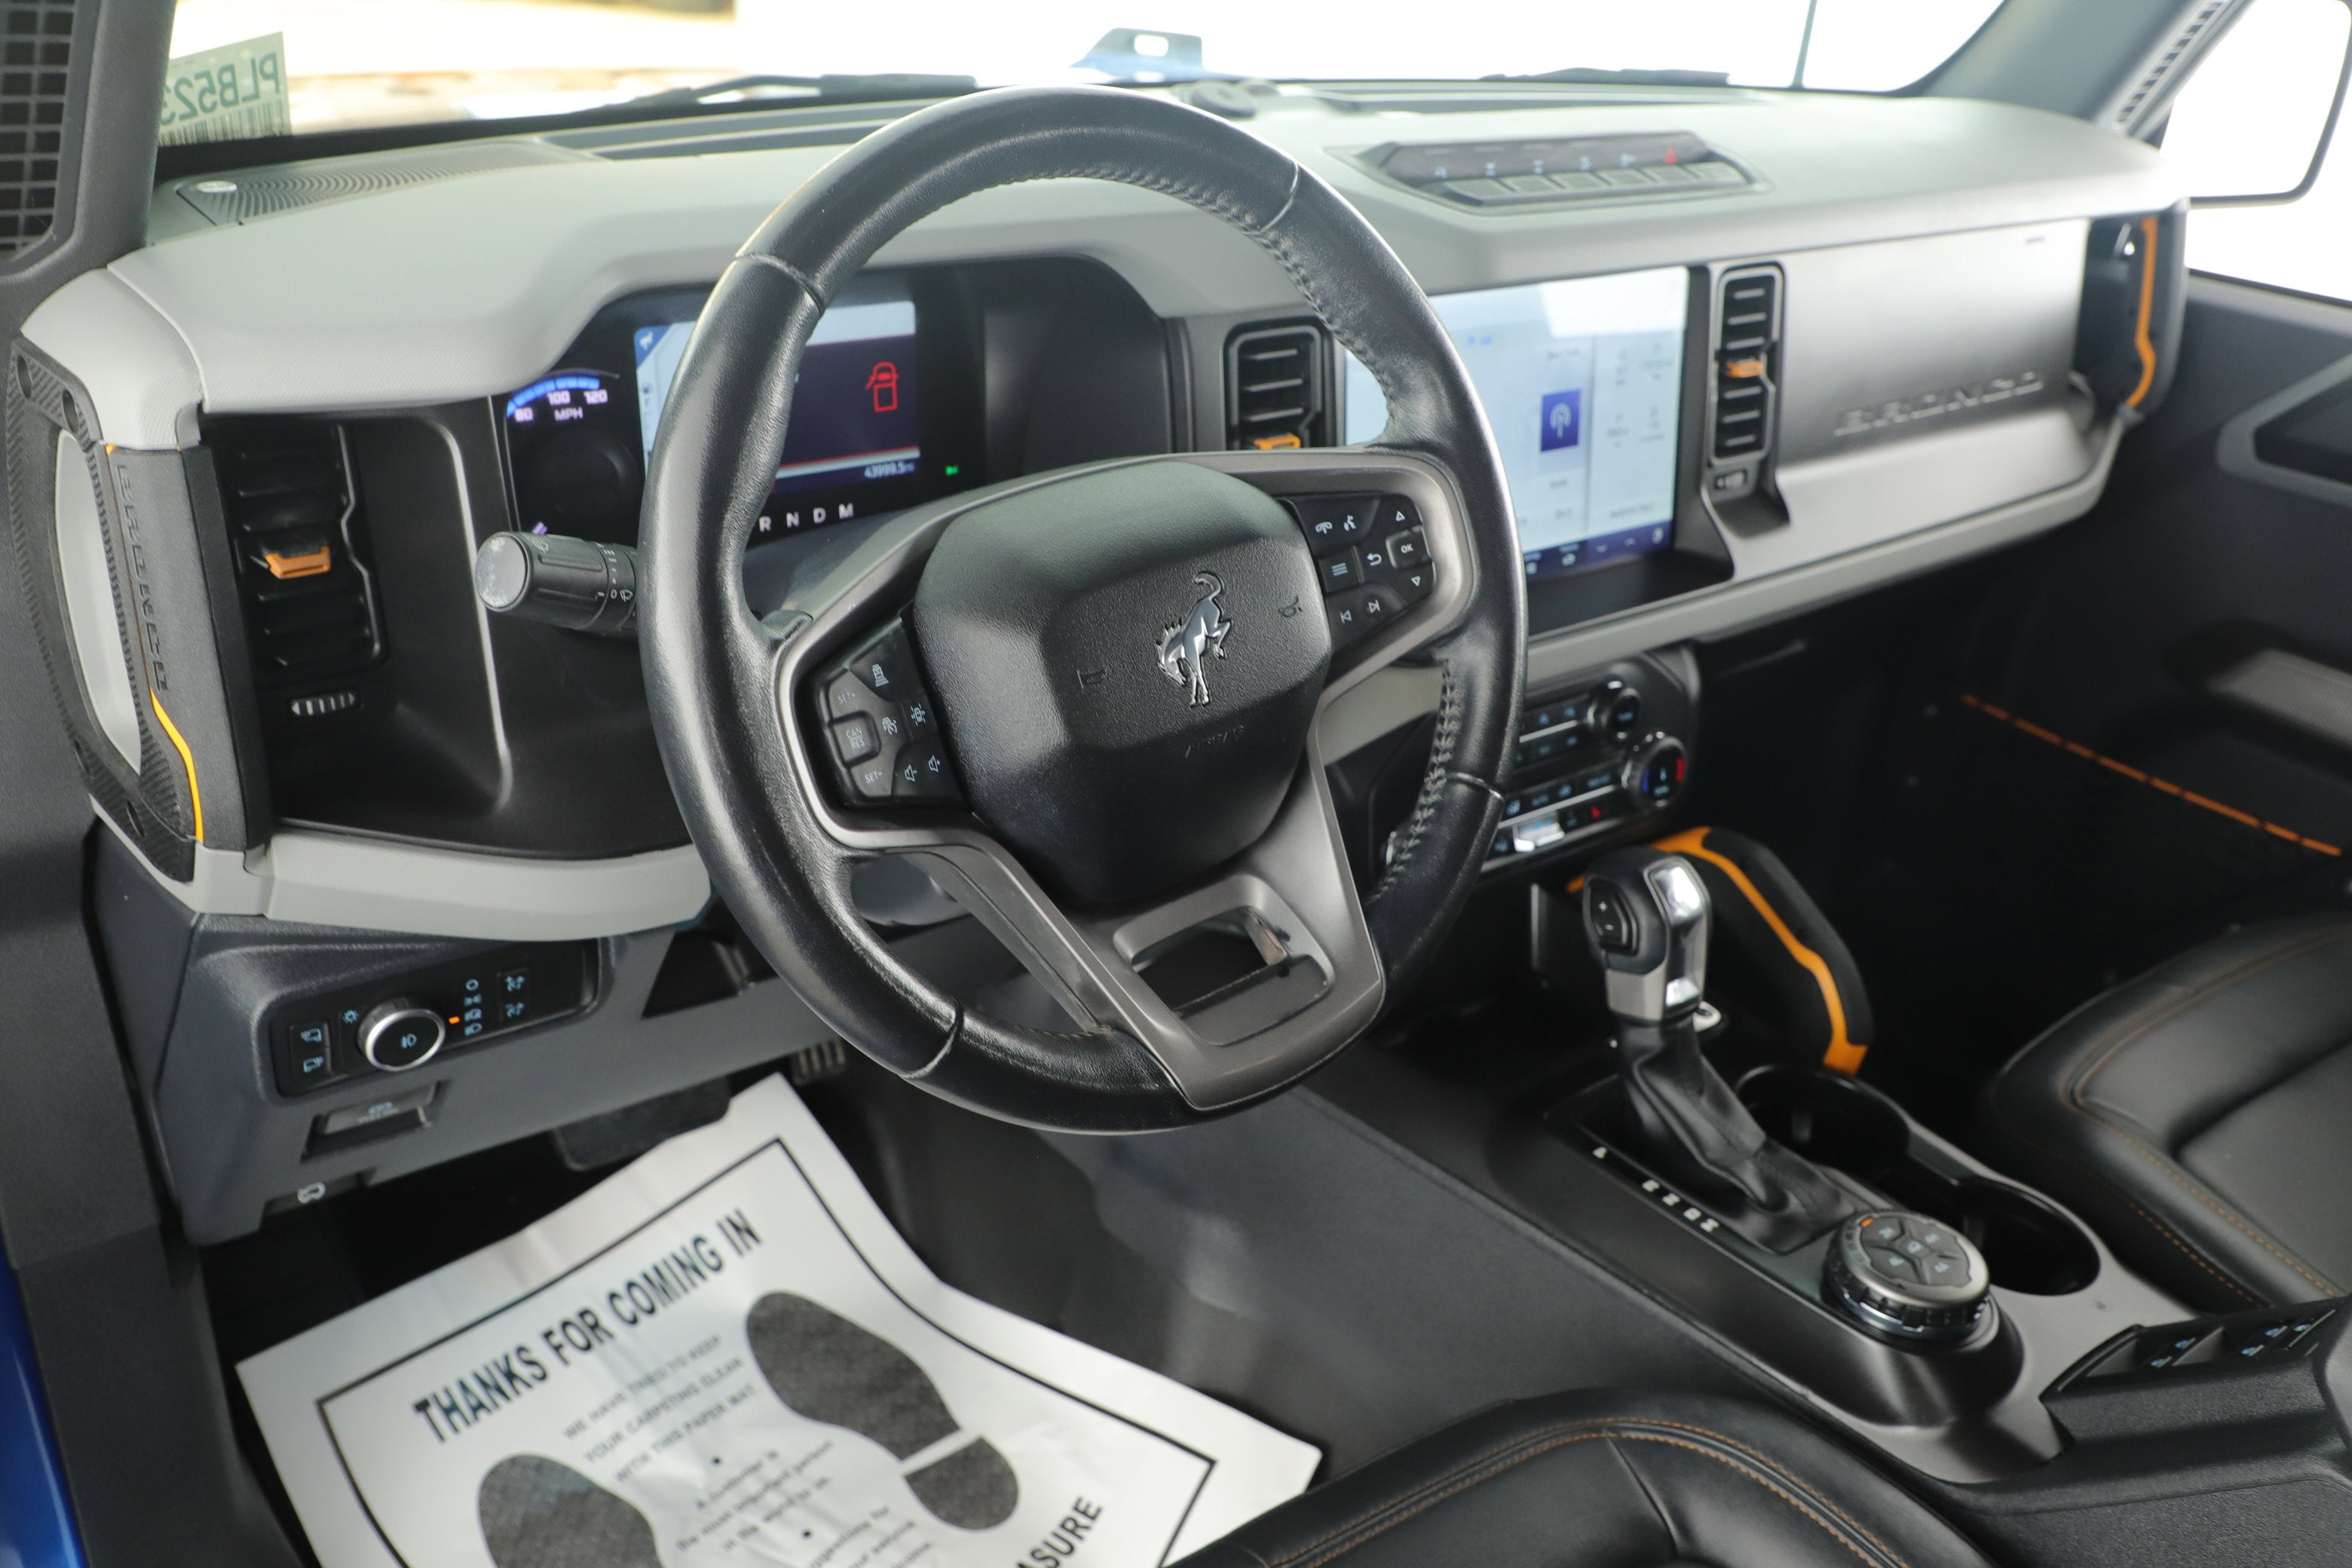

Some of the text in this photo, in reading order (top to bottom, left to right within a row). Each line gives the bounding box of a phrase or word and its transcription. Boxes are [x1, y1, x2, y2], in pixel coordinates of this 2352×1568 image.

[547, 390, 571, 406] 100
[583, 389, 608, 405] 120
[554, 406, 583, 421] MPH
[759, 503, 853, 532] R N D M
[1401, 544, 1413, 553] OK
[838, 692, 856, 705] SET+
[846, 727, 862, 738] CAN
[850, 737, 865, 750] RES
[412, 1208, 763, 1443] THANKS FOR COMING IN
